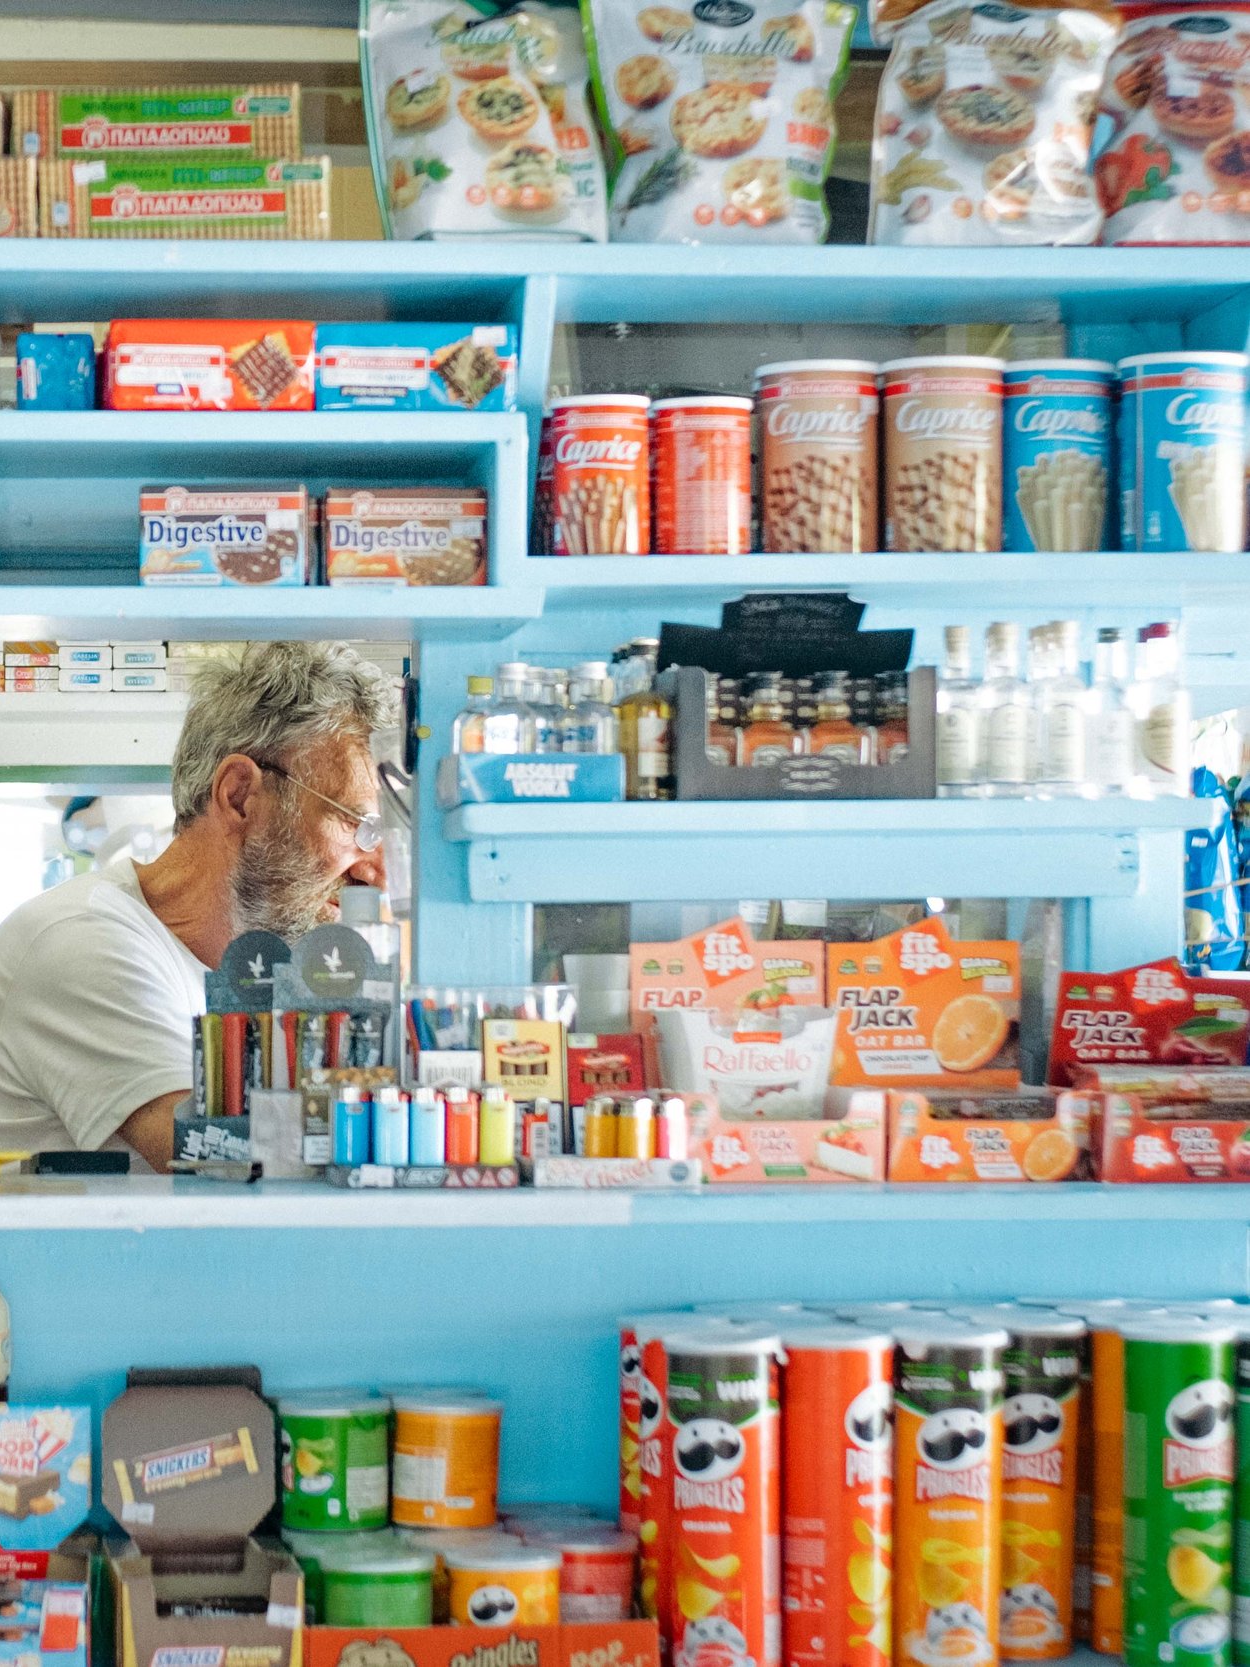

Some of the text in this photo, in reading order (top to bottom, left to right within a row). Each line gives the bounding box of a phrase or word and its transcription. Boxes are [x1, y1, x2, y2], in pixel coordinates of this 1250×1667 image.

[768, 403, 869, 438] Caprice
[896, 401, 995, 436] Caprice
[556, 433, 642, 466] Caprice
[148, 519, 264, 548] Digestive
[333, 524, 449, 550] Digestive
[504, 763, 578, 780] ABSOLUT
[512, 779, 571, 798] VODKA
[703, 932, 741, 955] fit
[900, 931, 940, 954] fit
[703, 952, 754, 977] spo
[900, 951, 952, 975] spo
[642, 990, 703, 1009] FLAP
[839, 988, 900, 1009] FLAP
[852, 1008, 915, 1032] JACK
[1063, 1011, 1130, 1028] FLAP
[855, 1036, 926, 1048] OAT BAR
[1072, 1028, 1144, 1047] JACK
[703, 1045, 811, 1073] Raffaello
[147, 1450, 209, 1479] SNICKERS
[673, 1475, 745, 1513] PRINGLES
